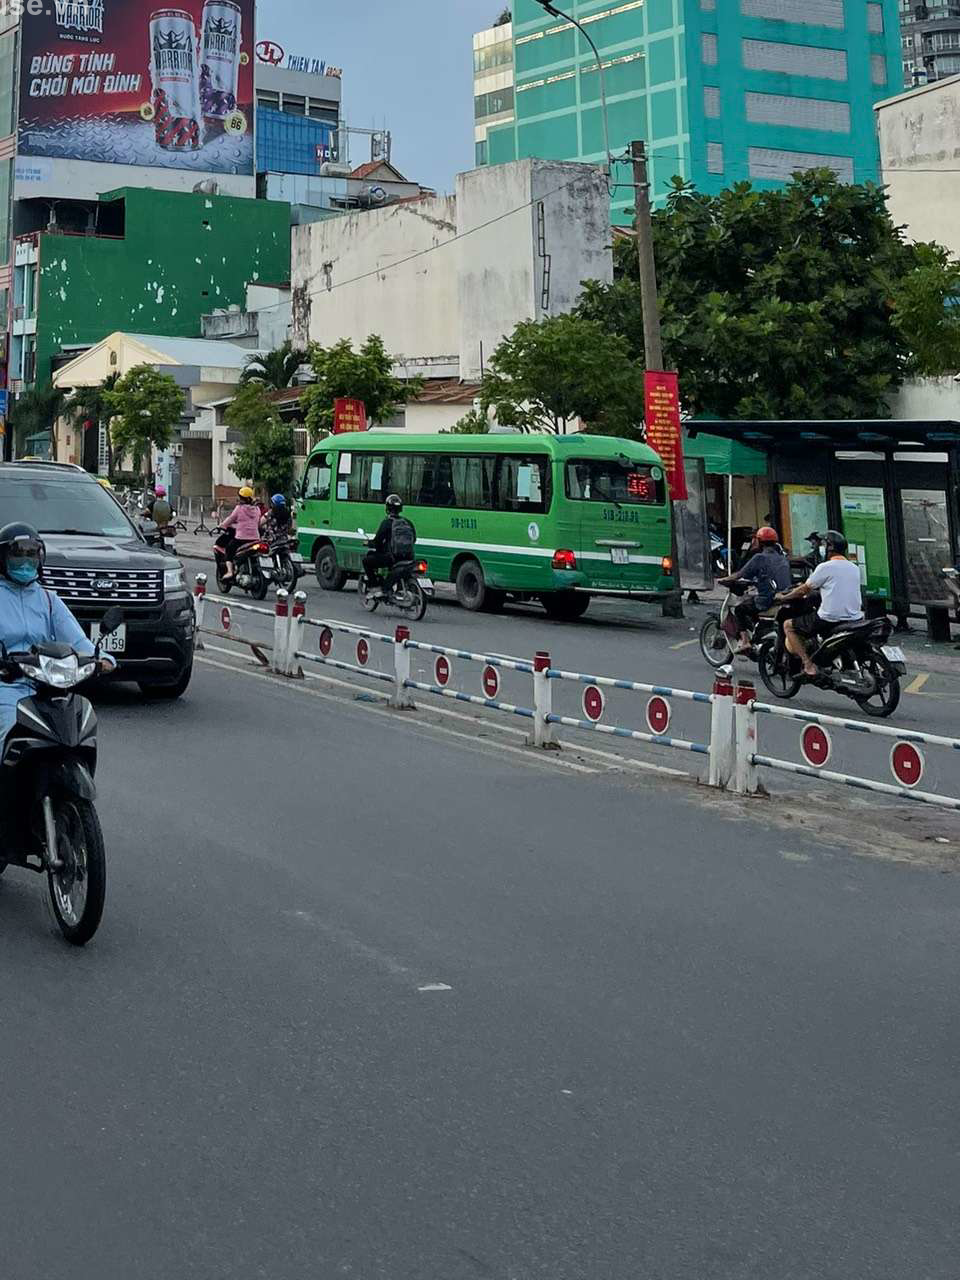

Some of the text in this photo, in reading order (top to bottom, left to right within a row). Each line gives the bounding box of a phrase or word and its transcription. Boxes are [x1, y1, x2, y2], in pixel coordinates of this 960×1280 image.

[53, 1, 104, 32] WARRIOR
[30, 50, 115, 74] BỪNG TỈNH
[71, 73, 100, 95] MỚI
[103, 71, 141, 93] ĐỈNH
